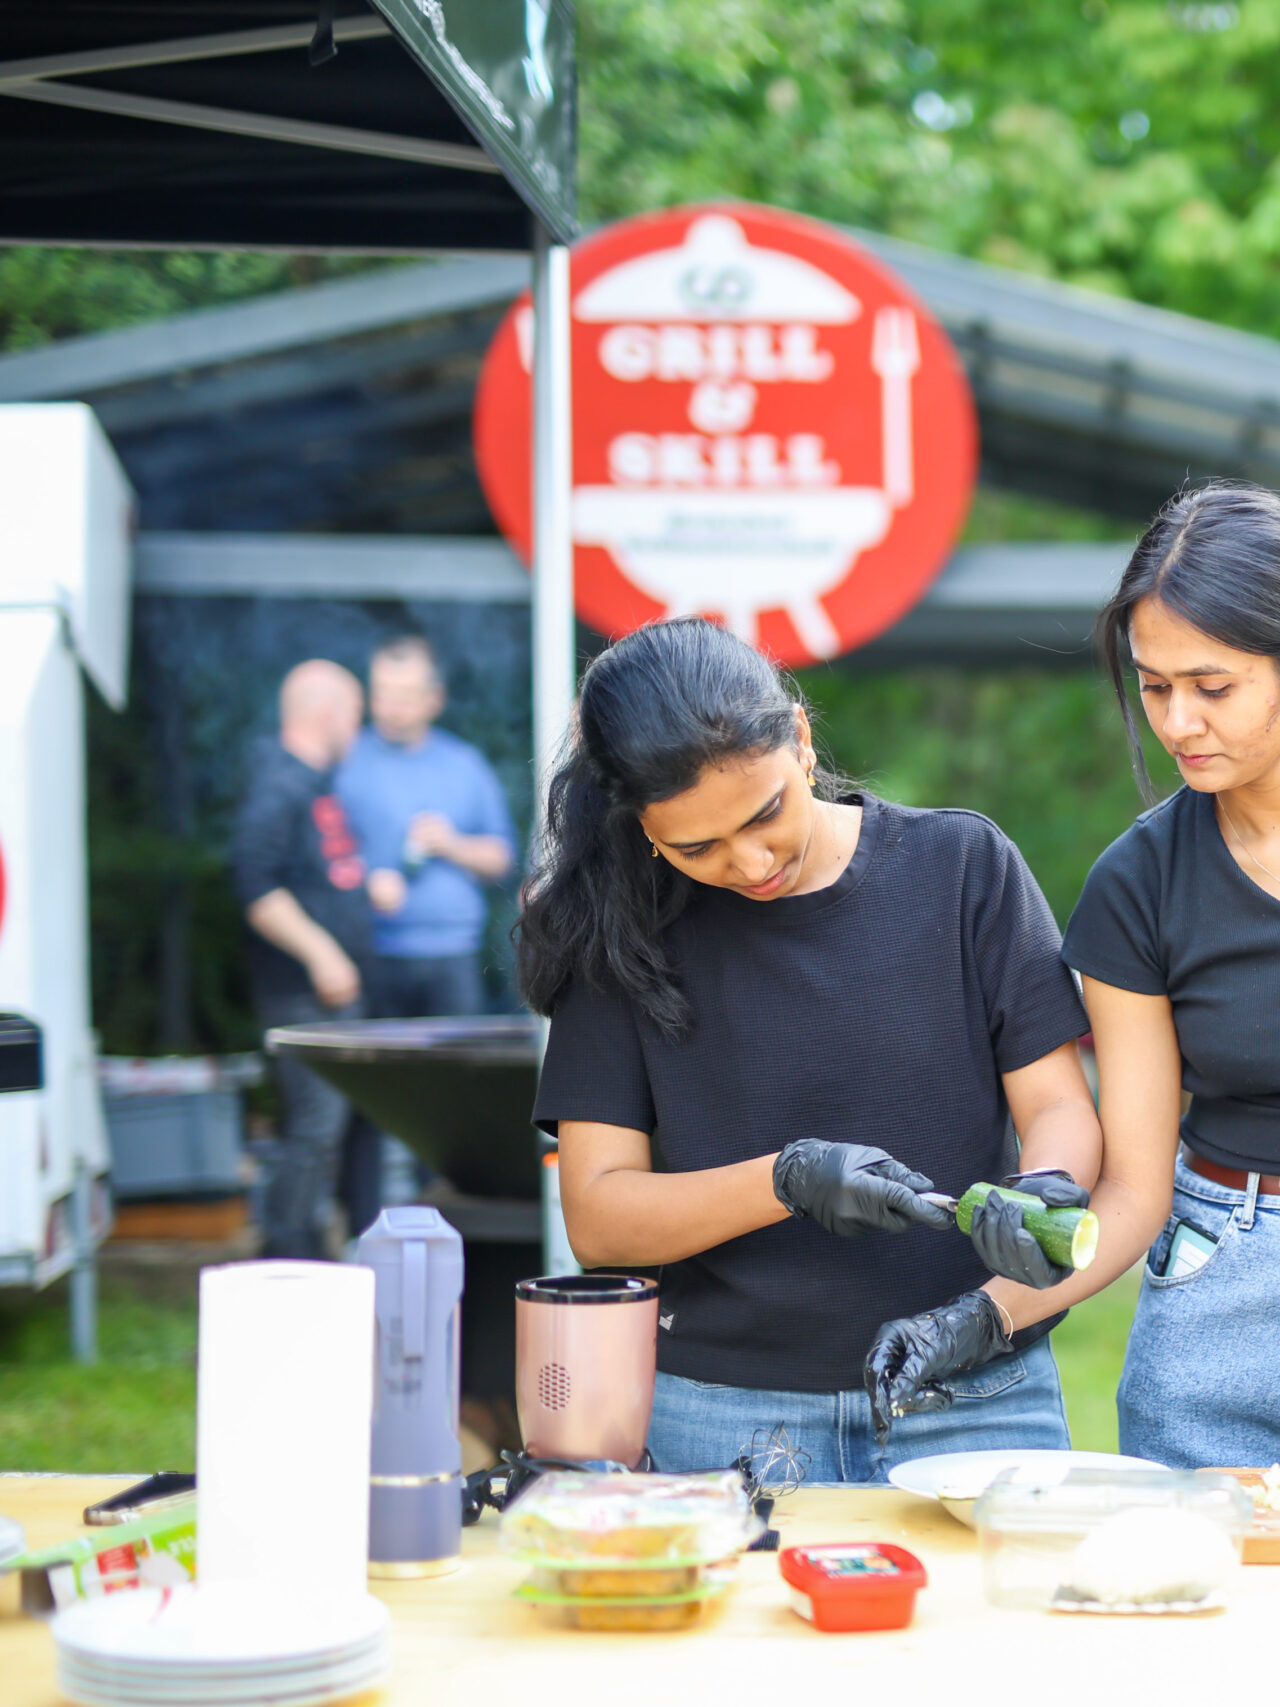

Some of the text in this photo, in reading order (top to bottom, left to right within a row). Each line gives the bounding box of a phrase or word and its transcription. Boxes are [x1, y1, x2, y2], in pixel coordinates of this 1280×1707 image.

[599, 324, 835, 382] GRILL
[687, 379, 757, 434] &
[608, 432, 842, 486] SKILL
